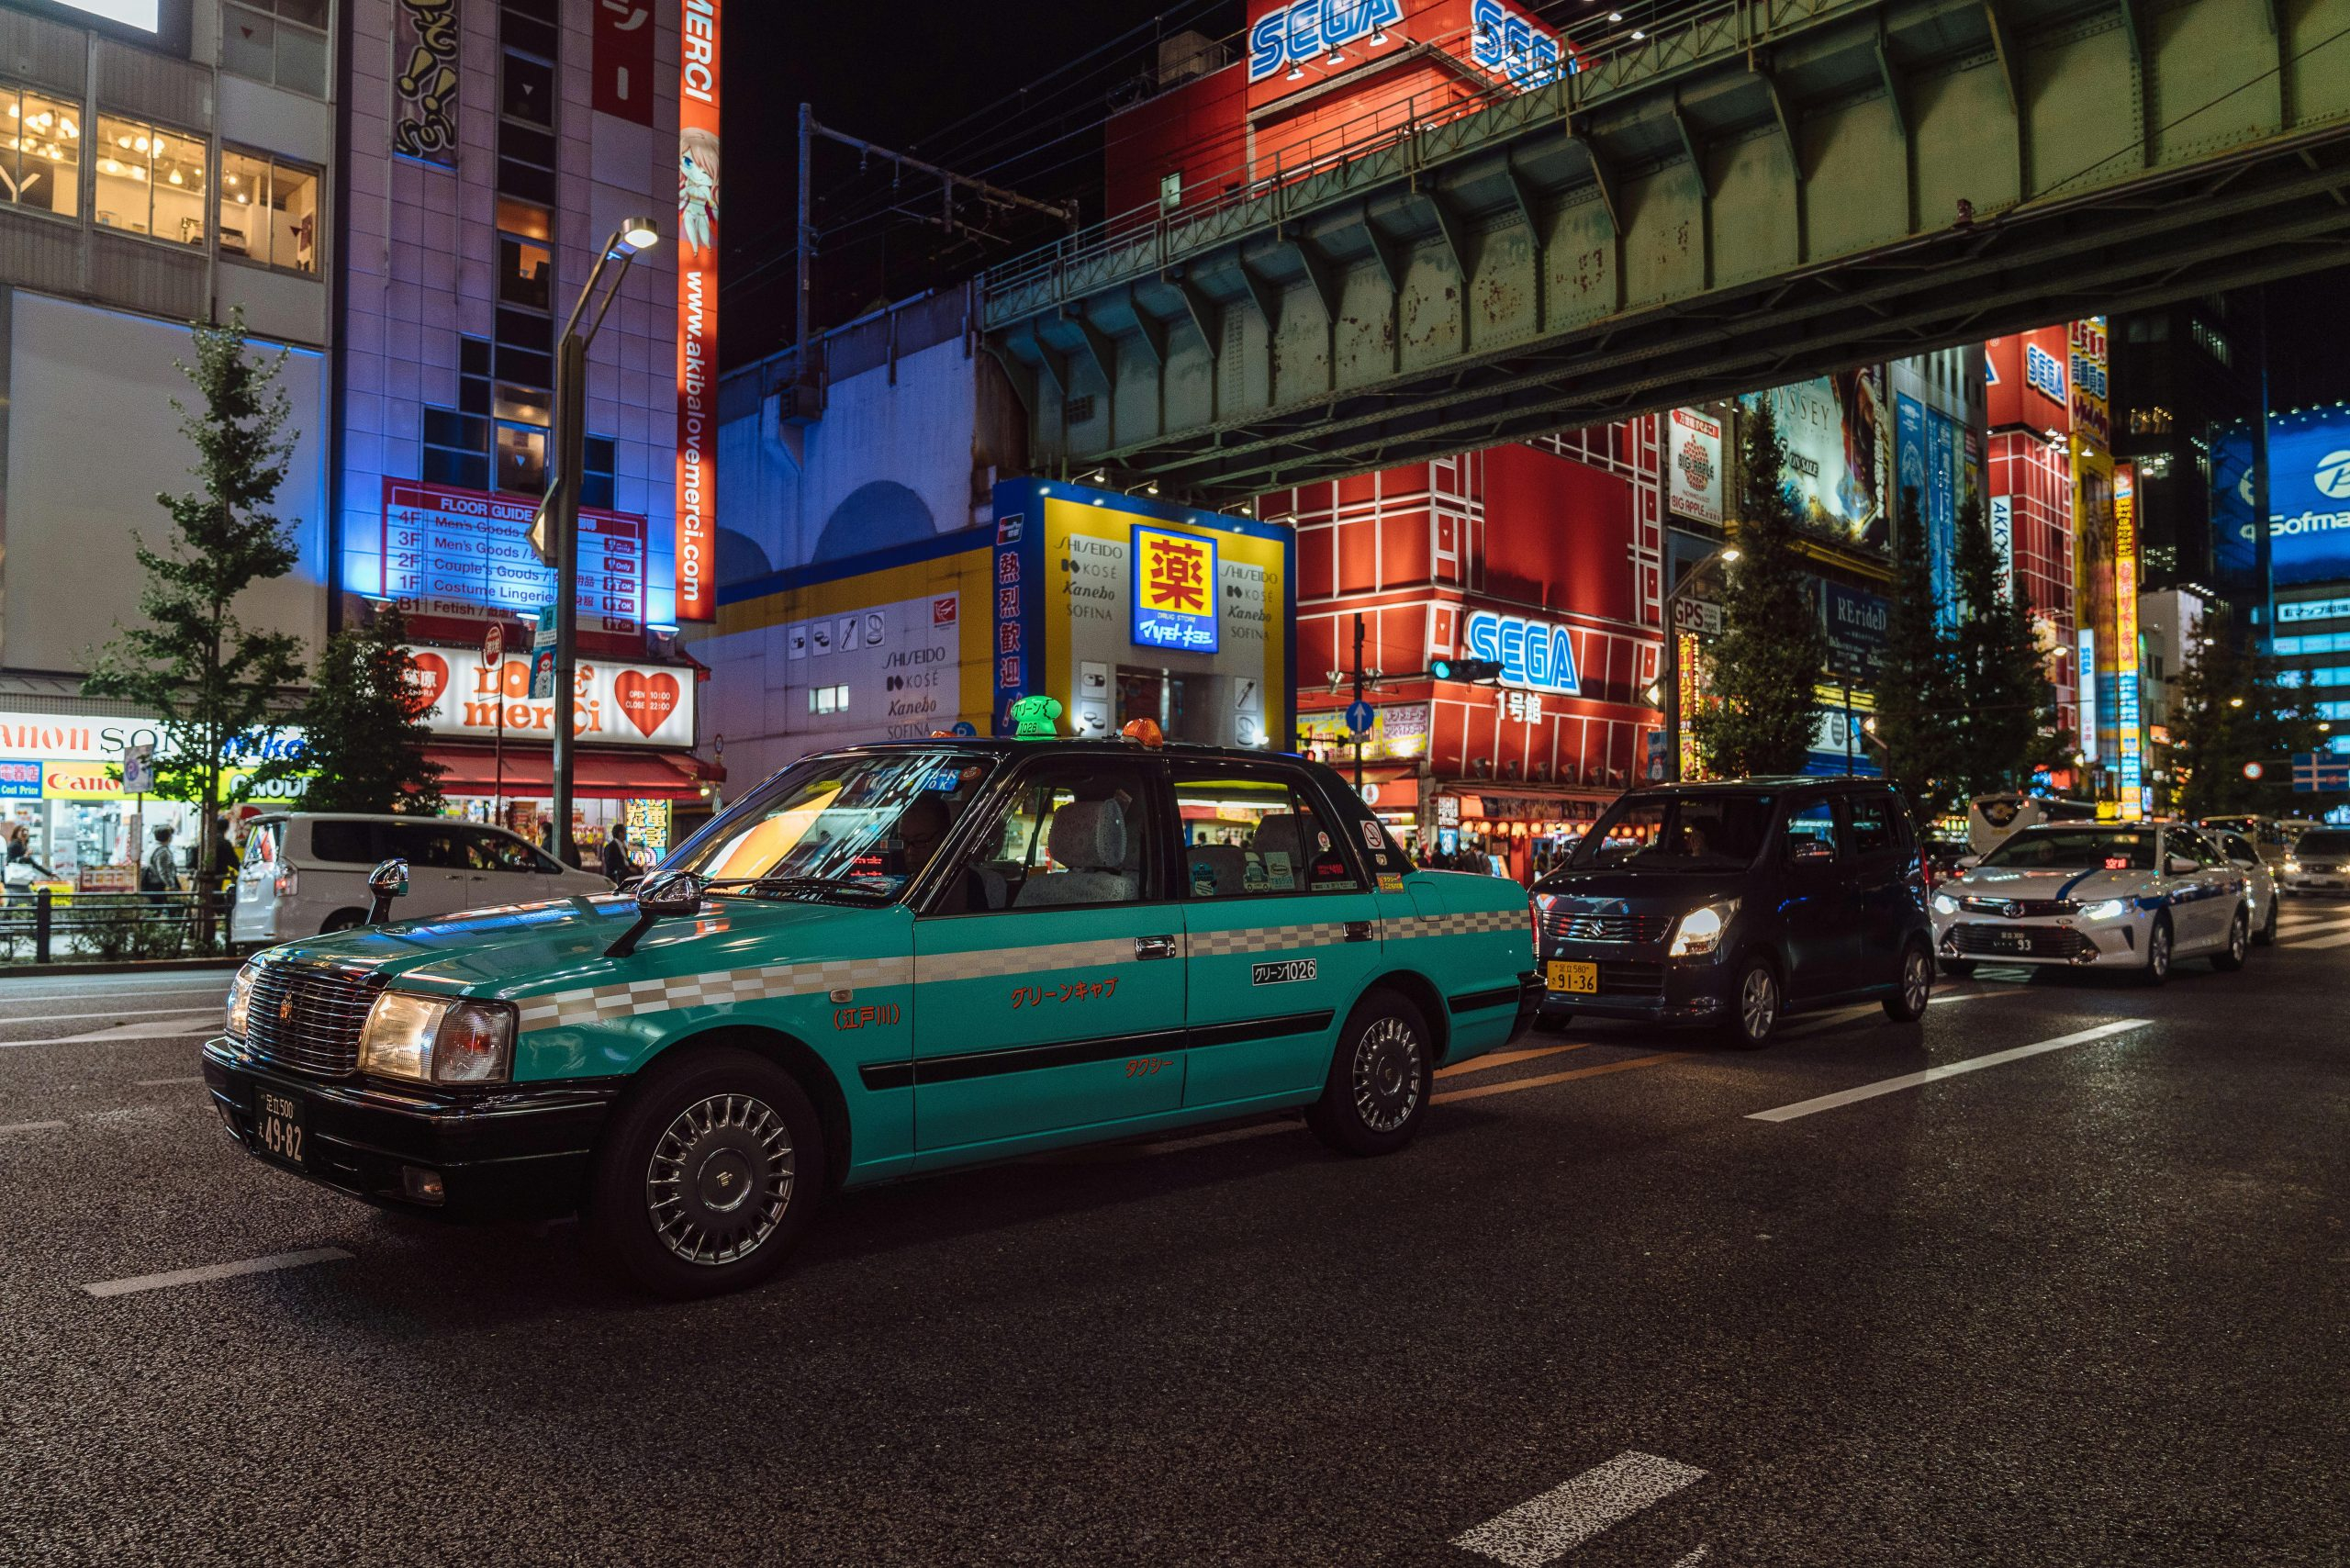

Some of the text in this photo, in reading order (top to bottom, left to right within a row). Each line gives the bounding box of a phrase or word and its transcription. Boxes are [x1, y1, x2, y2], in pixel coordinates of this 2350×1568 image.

[1248, 0, 1405, 83] SEGA
[2027, 342, 2067, 406] SEGA
[684, 272, 705, 600] www.akibalovemerci.com
[1678, 454, 1714, 481] BIG APPLE
[1791, 454, 1818, 476] ON SALE
[441, 498, 533, 521] FLOOR GUIDE
[1671, 495, 1684, 510] BIG
[1685, 499, 1705, 516] APPLE
[398, 511, 520, 537] 4F Men's Goods
[398, 532, 519, 558] 3F Men's Goods
[1054, 535, 1123, 560] SHISEIDO
[398, 553, 421, 568] 2F
[434, 558, 493, 576] Couple's
[497, 566, 540, 581] Goods
[1150, 539, 1204, 610] 薬
[1220, 565, 1278, 584] SHISEIDO
[399, 575, 420, 589] 1F
[434, 580, 496, 597] Costume
[1062, 580, 1115, 601] Kanebo
[398, 597, 420, 612] B1
[434, 601, 476, 616] Fetish
[1067, 604, 1113, 622] SOFINA
[1227, 605, 1271, 622] Kanebo
[1675, 600, 1704, 629] GPS
[1837, 597, 1886, 631] RErideD
[1231, 626, 1270, 641] SOFINA
[882, 646, 946, 669] SHISEIDO
[1466, 610, 1581, 696] SEGA
[2080, 647, 2091, 676] SEGA
[625, 700, 670, 711] CLOSE 22:00
[629, 690, 671, 700] OPEN 10:00
[889, 697, 936, 716] Kanebo
[1495, 692, 1542, 725] 1号館
[100, 725, 189, 754] SON
[888, 723, 931, 740] SOFINA
[1020, 722, 1037, 734] 1026
[48, 773, 120, 791] Cano
[1012, 978, 1118, 1009] グリーンキャブ
[1559, 974, 1595, 991] 91-36
[1125, 1058, 1173, 1079] タクシー
[265, 1116, 302, 1162] 49-82
